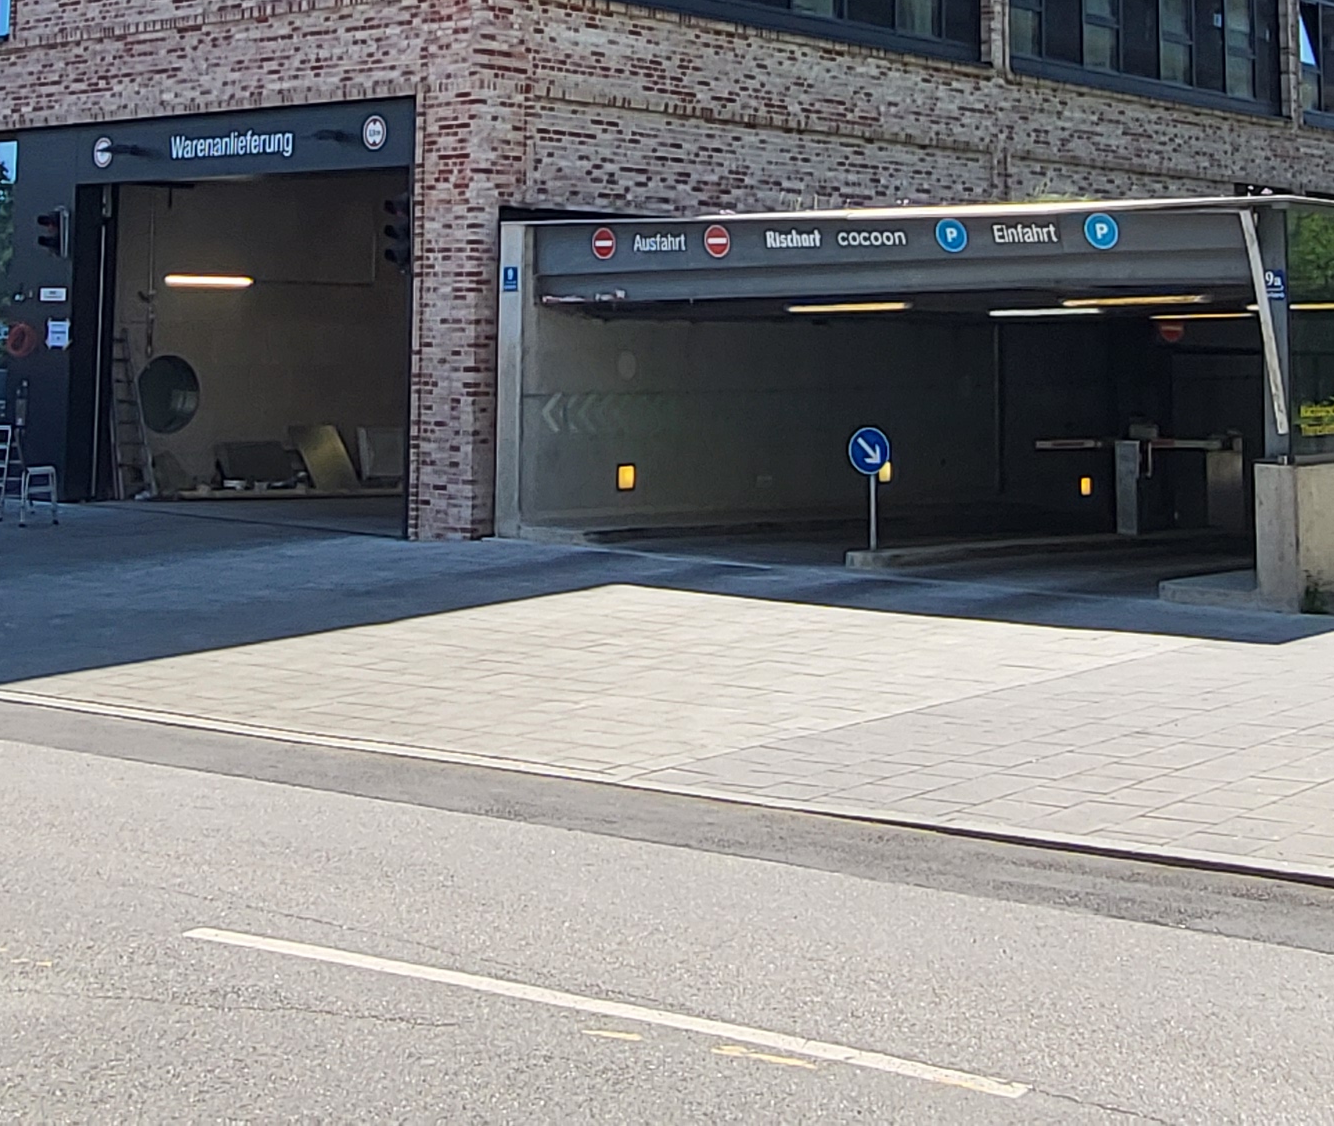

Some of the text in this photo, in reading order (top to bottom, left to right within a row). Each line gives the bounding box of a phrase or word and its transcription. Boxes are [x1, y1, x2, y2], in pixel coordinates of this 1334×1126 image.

[170, 130, 293, 159] Warenanlieferung
[633, 234, 686, 252] Ausfahrt
[765, 229, 907, 248] Rischart cocoon
[992, 224, 1059, 243] Einfahrt
